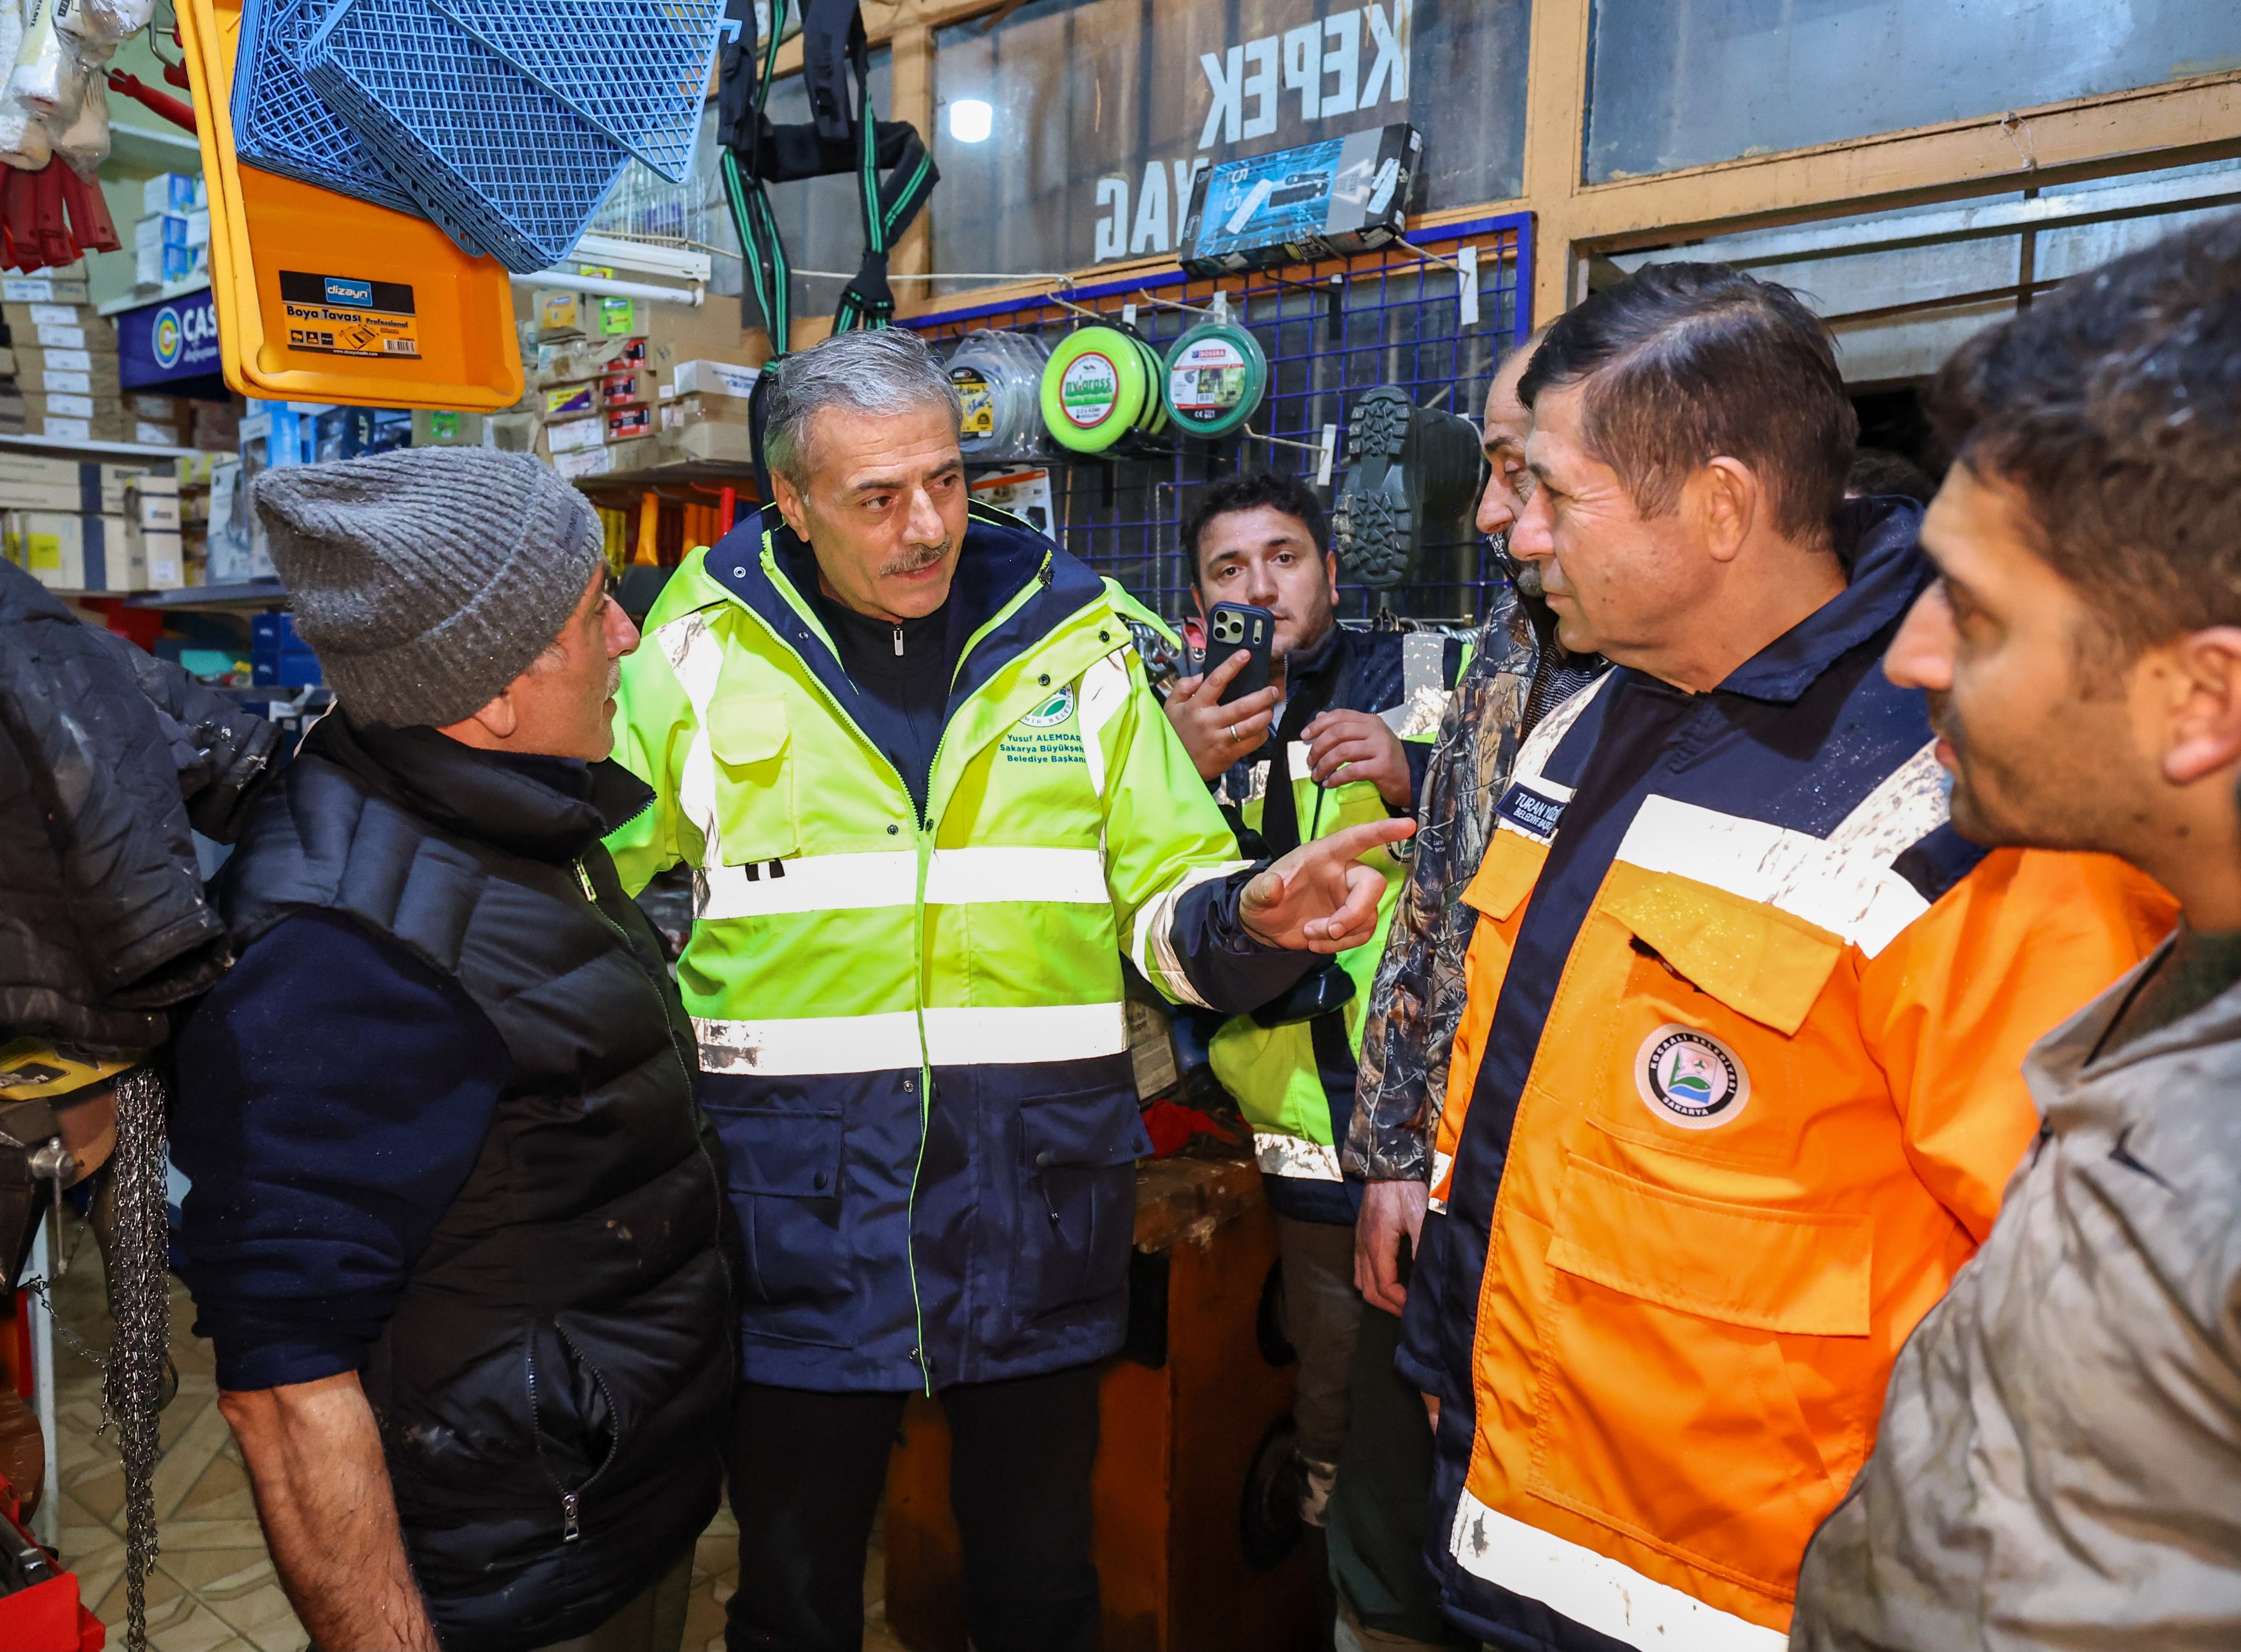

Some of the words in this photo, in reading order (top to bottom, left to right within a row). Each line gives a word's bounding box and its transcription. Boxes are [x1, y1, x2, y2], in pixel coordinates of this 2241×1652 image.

[327, 285, 368, 299] dizayn
[287, 305, 318, 320] Boya
[322, 309, 361, 322] Tavası
[366, 318, 408, 328] Professional
[1036, 734, 1081, 742] ALEMDAR
[1000, 744, 1037, 753] Sakarya
[1007, 755, 1048, 763] Belediye
[1514, 792, 1548, 817] TURAN
[1662, 1097, 1709, 1116] SAKARYA
